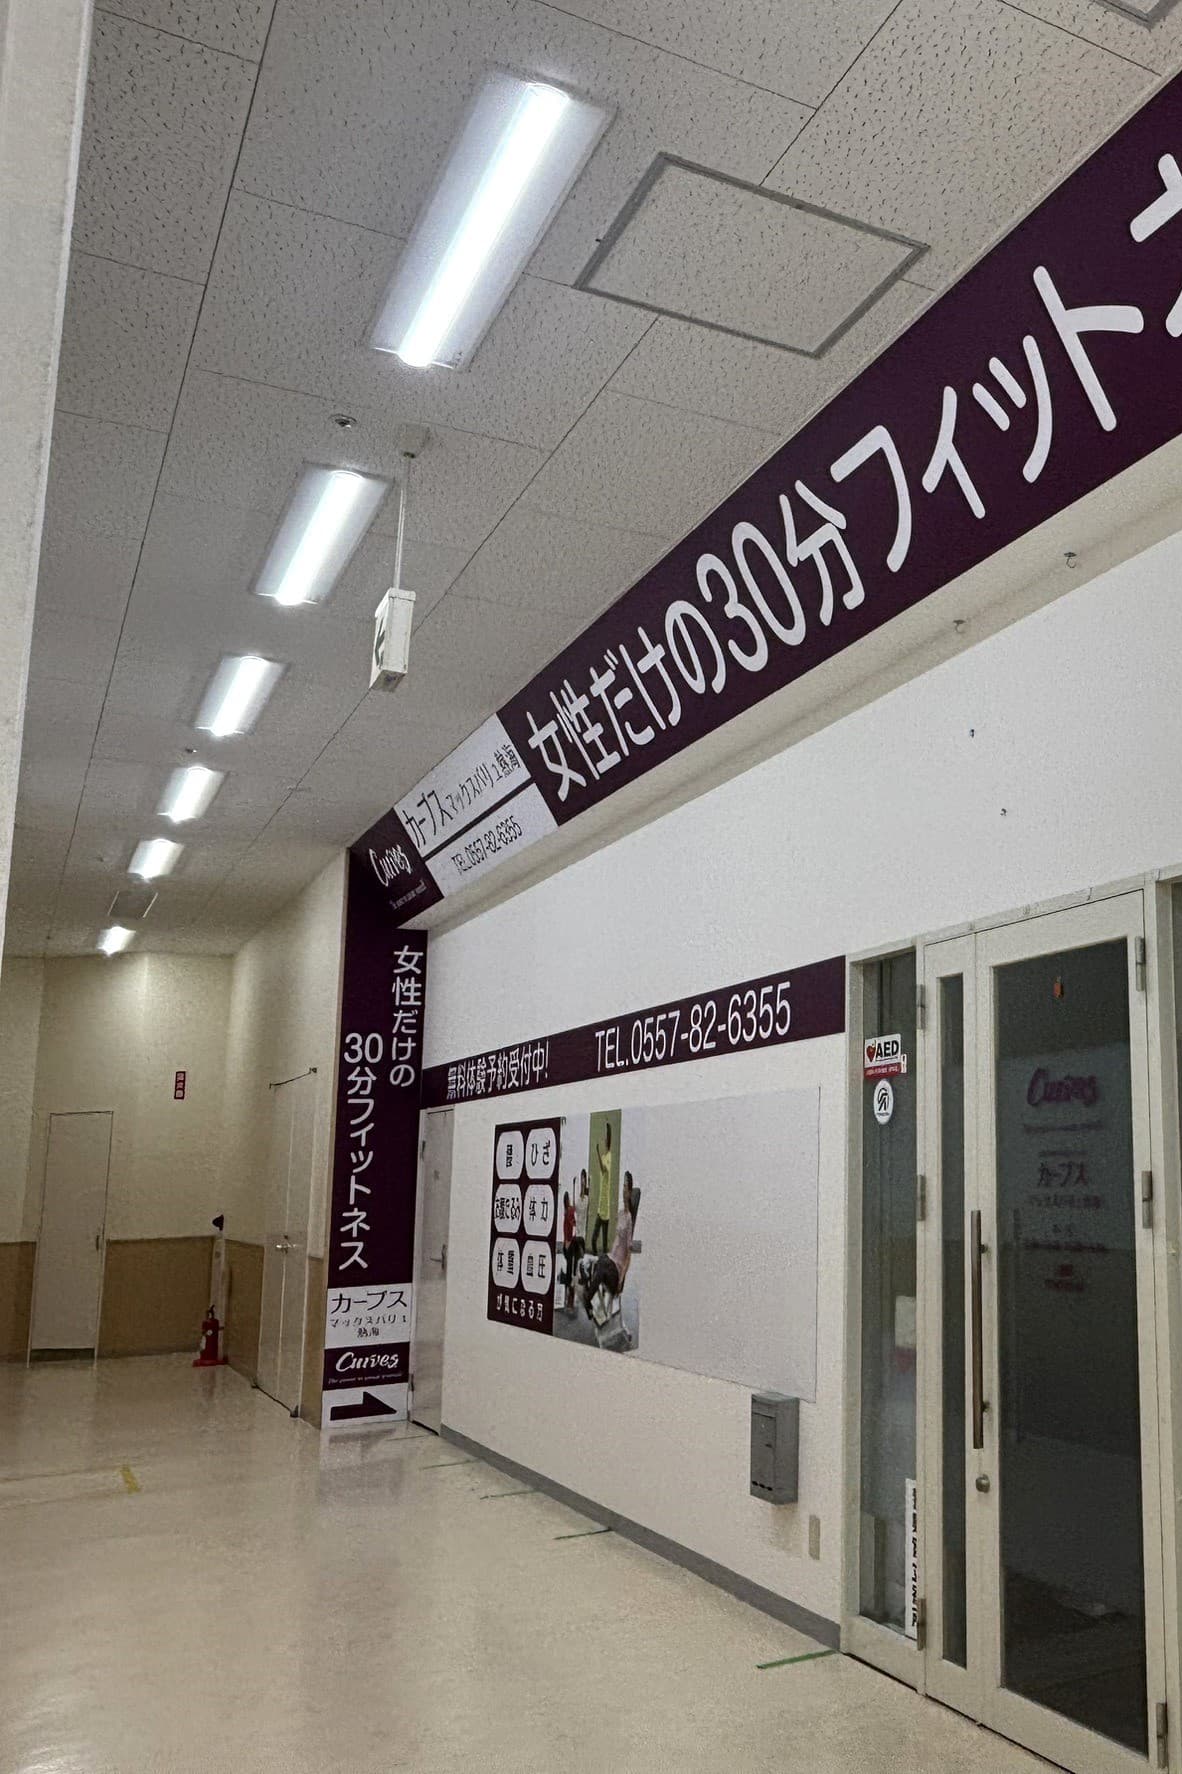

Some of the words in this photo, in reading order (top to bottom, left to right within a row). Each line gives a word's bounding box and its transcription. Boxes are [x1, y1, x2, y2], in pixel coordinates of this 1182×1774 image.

[402, 790, 454, 848] カーブス
[368, 844, 412, 887] Curves
[389, 945, 424, 1087] 女性だけの
[876, 1040, 899, 1058] AED
[339, 1032, 383, 1271] 30分フィットネス
[330, 1290, 408, 1315] カーブス
[335, 1351, 400, 1373] Curves
